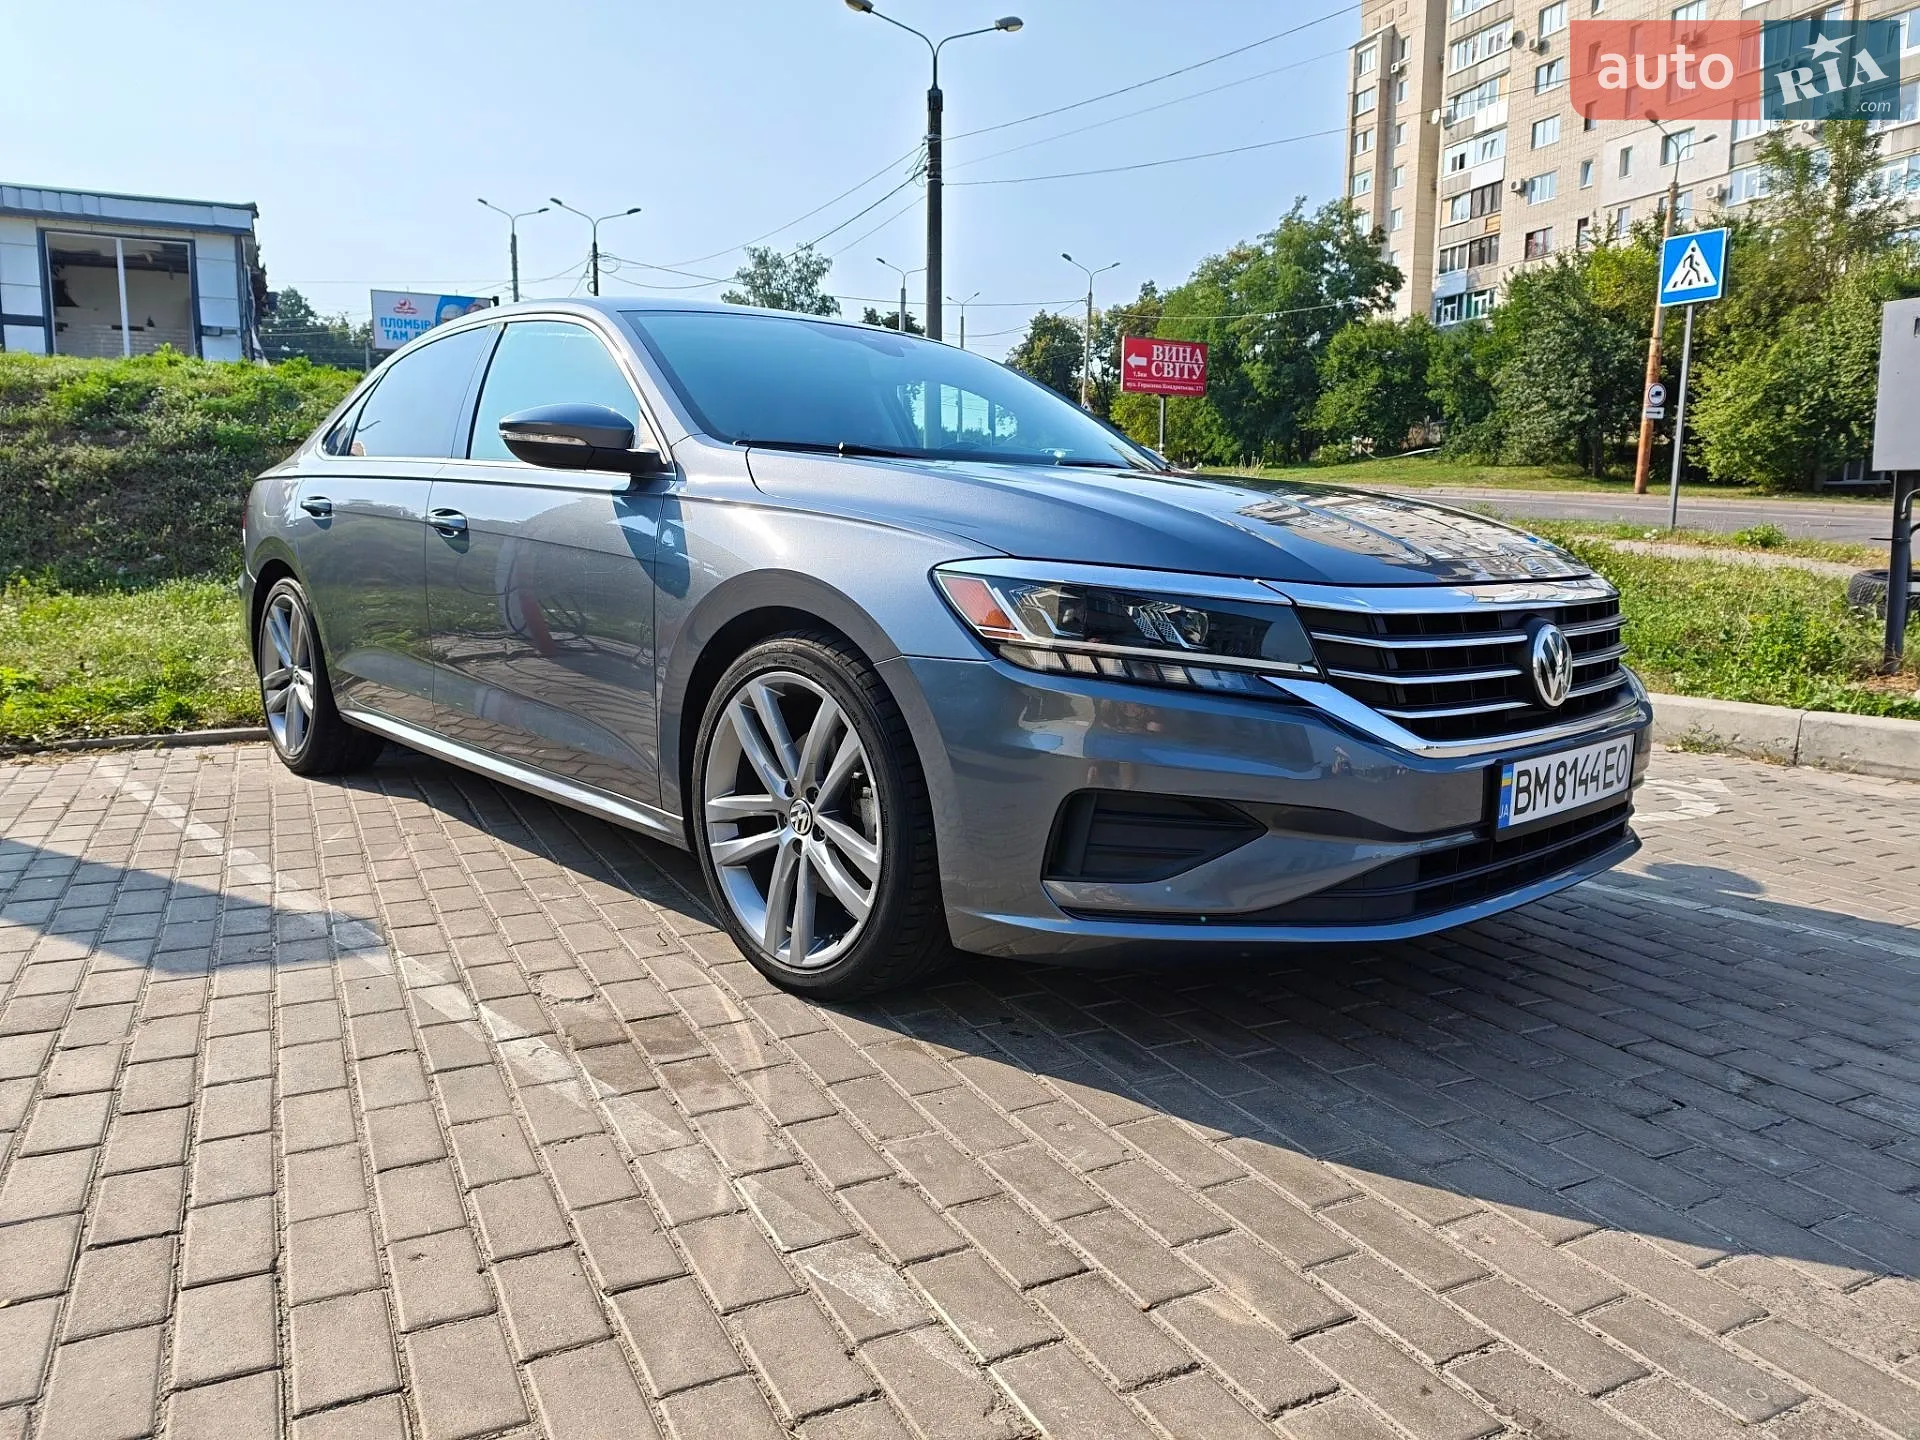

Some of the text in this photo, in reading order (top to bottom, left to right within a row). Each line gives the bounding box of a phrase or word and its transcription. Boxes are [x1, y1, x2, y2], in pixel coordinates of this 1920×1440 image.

[380, 317, 431, 330] ПЛОМБІР
[1151, 344, 1204, 364] ВИНА
[1151, 361, 1204, 379] СВІТУ
